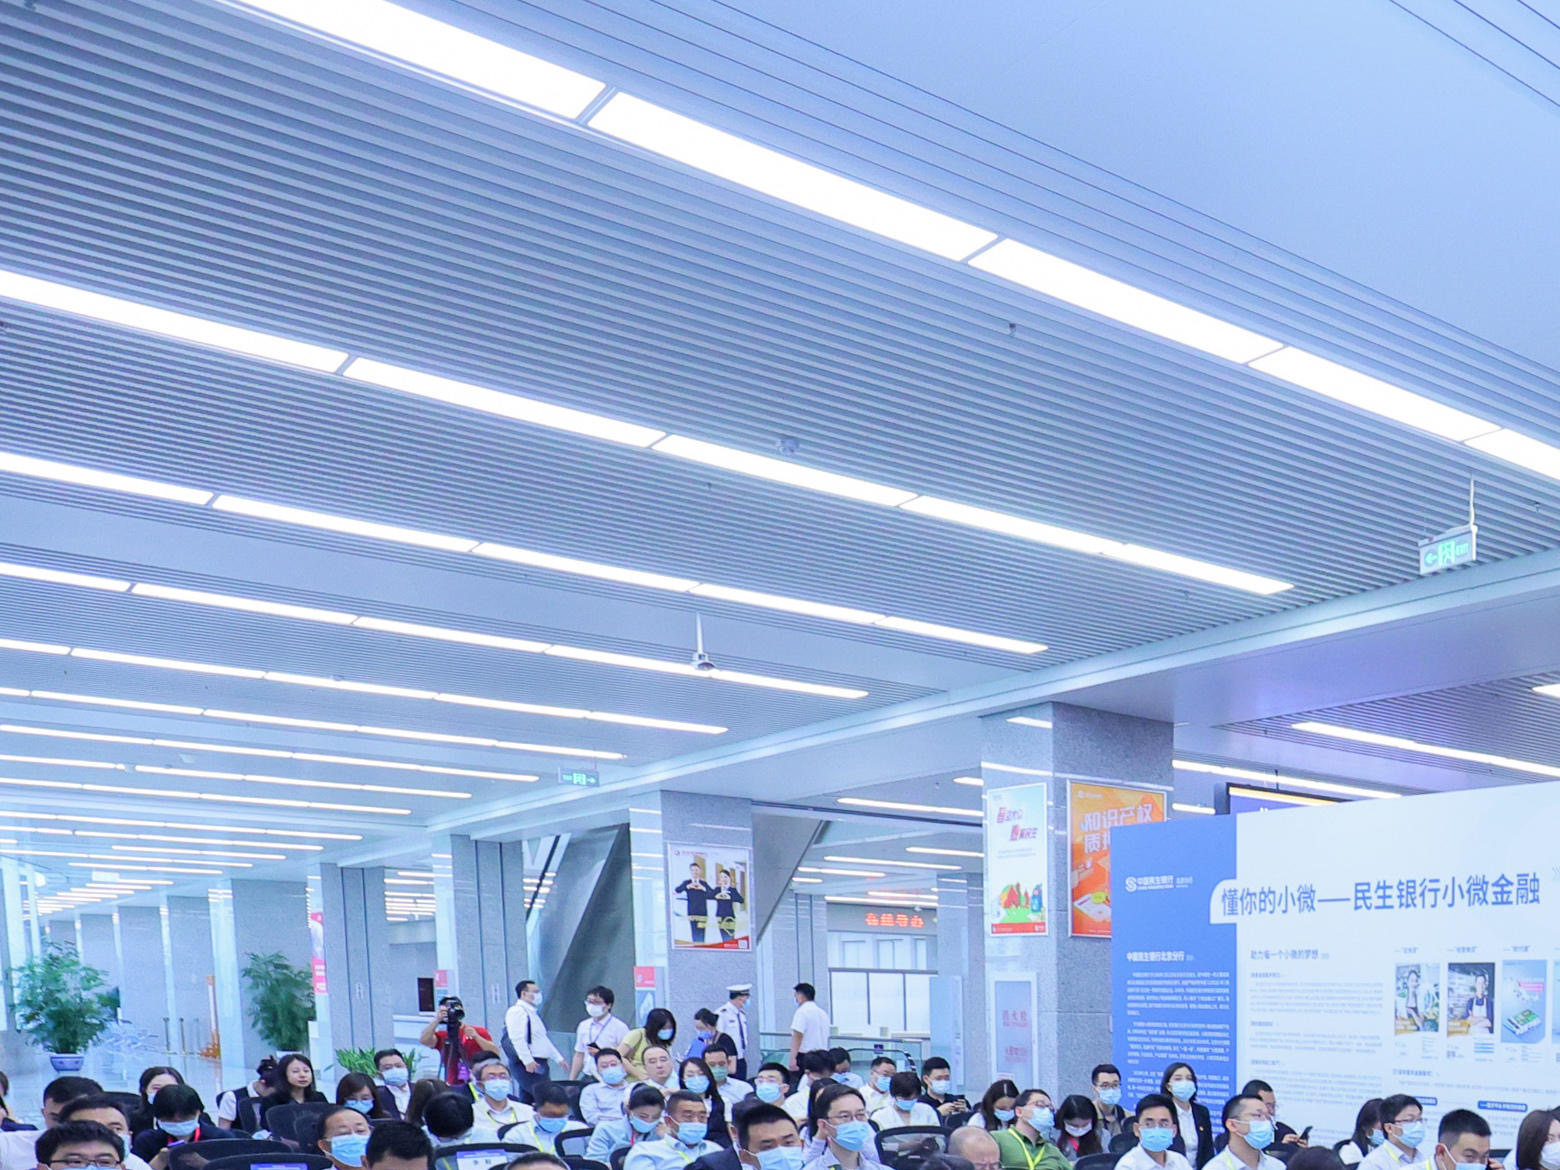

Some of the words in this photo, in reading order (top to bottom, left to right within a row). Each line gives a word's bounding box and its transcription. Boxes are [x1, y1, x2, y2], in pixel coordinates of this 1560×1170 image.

[1221, 873, 1540, 917] 懂你的小微——民生银行小微金融
